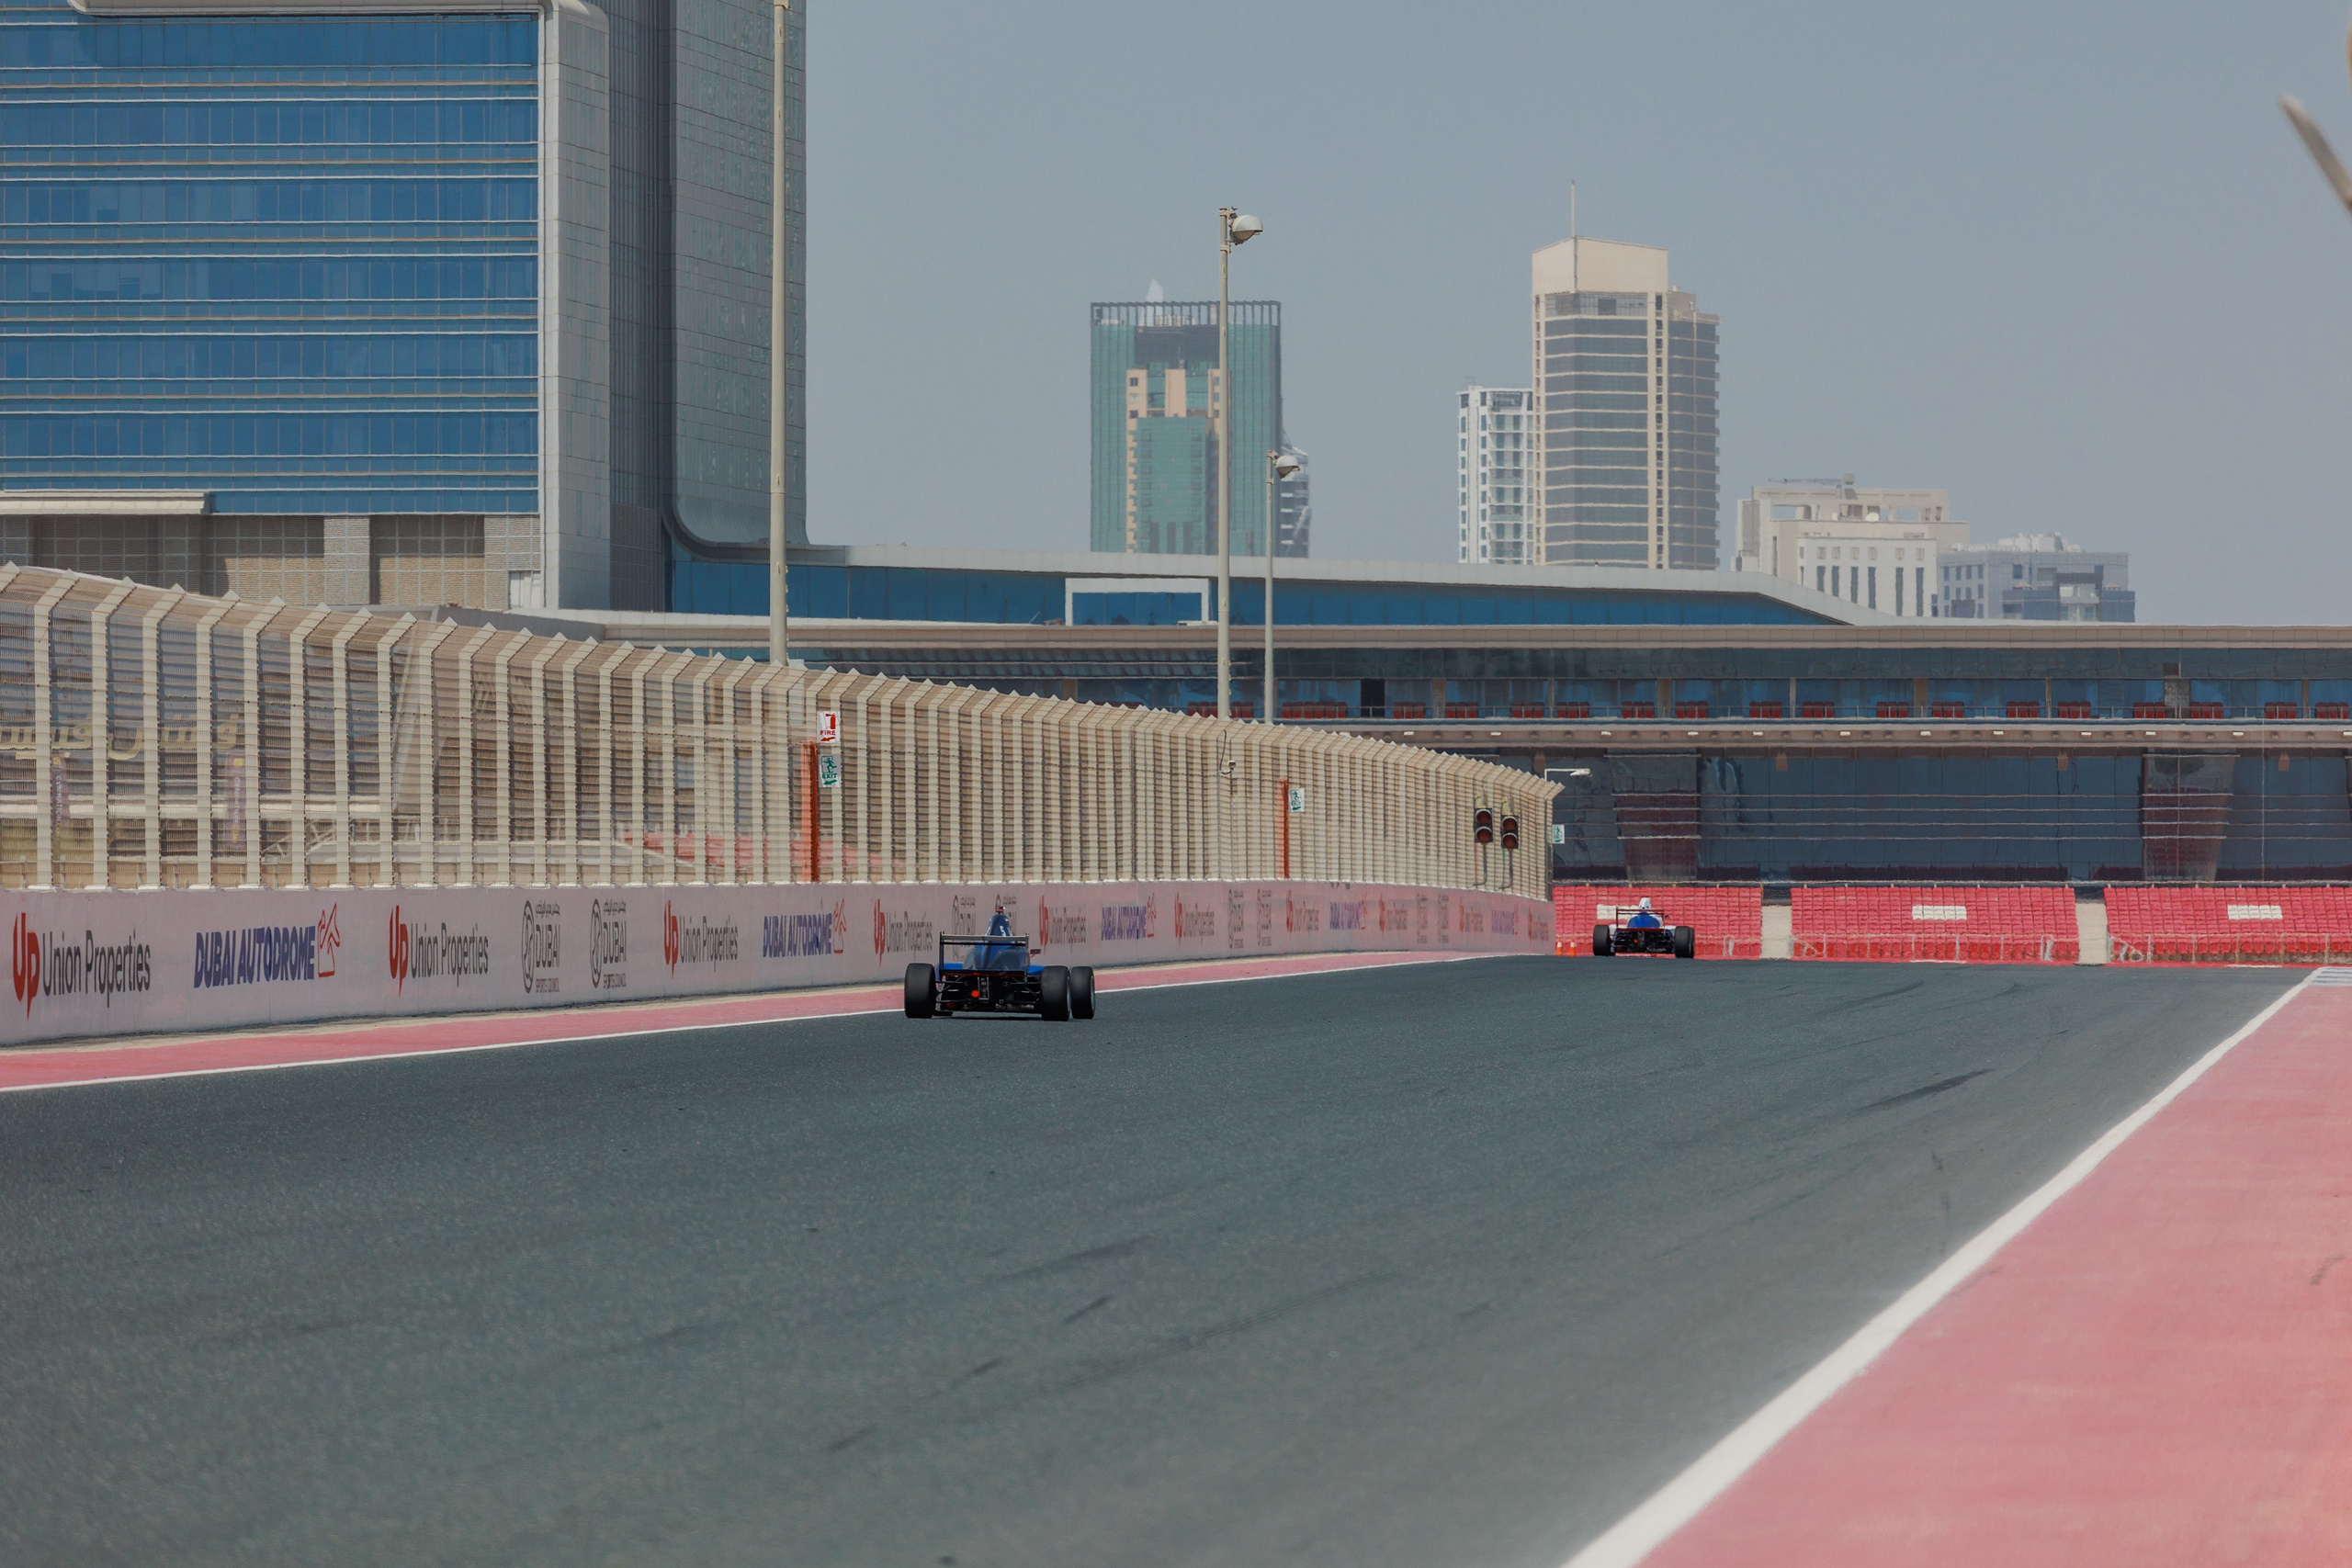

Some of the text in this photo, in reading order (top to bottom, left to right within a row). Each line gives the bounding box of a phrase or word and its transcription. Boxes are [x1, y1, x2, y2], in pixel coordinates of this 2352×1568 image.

[193, 925, 316, 989] DUBAI AUTODROME
[410, 922, 489, 987] Union Properties
[536, 923, 560, 968] DUBAI
[603, 920, 627, 964] DUBAI
[679, 915, 739, 972] Union Properties
[763, 912, 832, 958] DUBAI AUTODROME
[42, 929, 151, 1008] Union Properties
